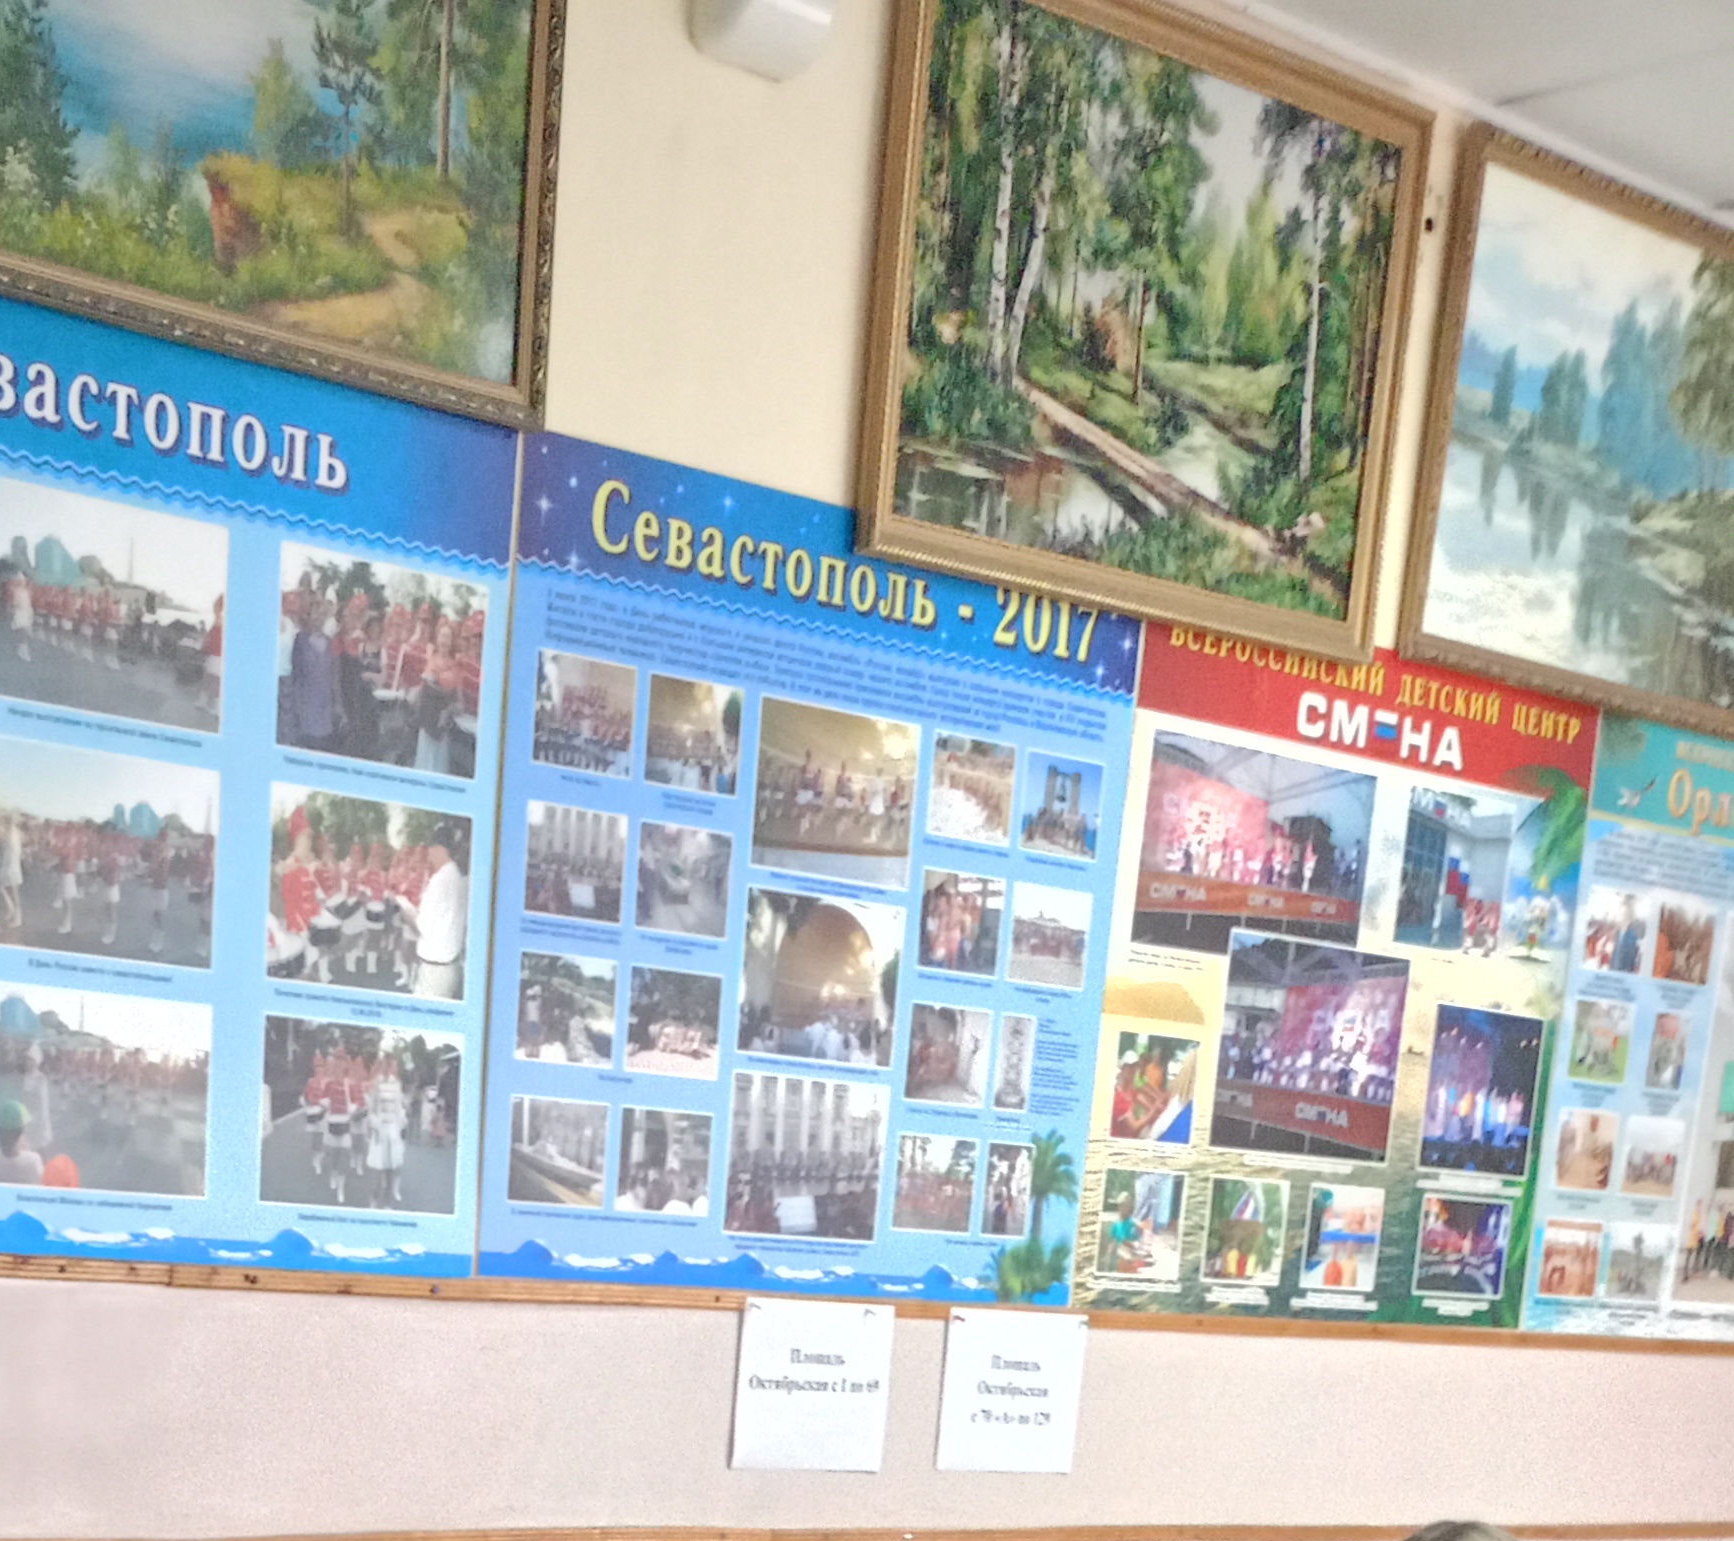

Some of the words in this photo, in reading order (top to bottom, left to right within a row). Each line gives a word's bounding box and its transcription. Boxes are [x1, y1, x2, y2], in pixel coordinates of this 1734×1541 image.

[590, 479, 938, 629] Севастополь
[993, 585, 1101, 664] 2017
[1395, 673, 1502, 725] ДЕТСКИЙ
[1511, 702, 1581, 744] ЦЕНТР
[1667, 768, 1734, 838] Орл
